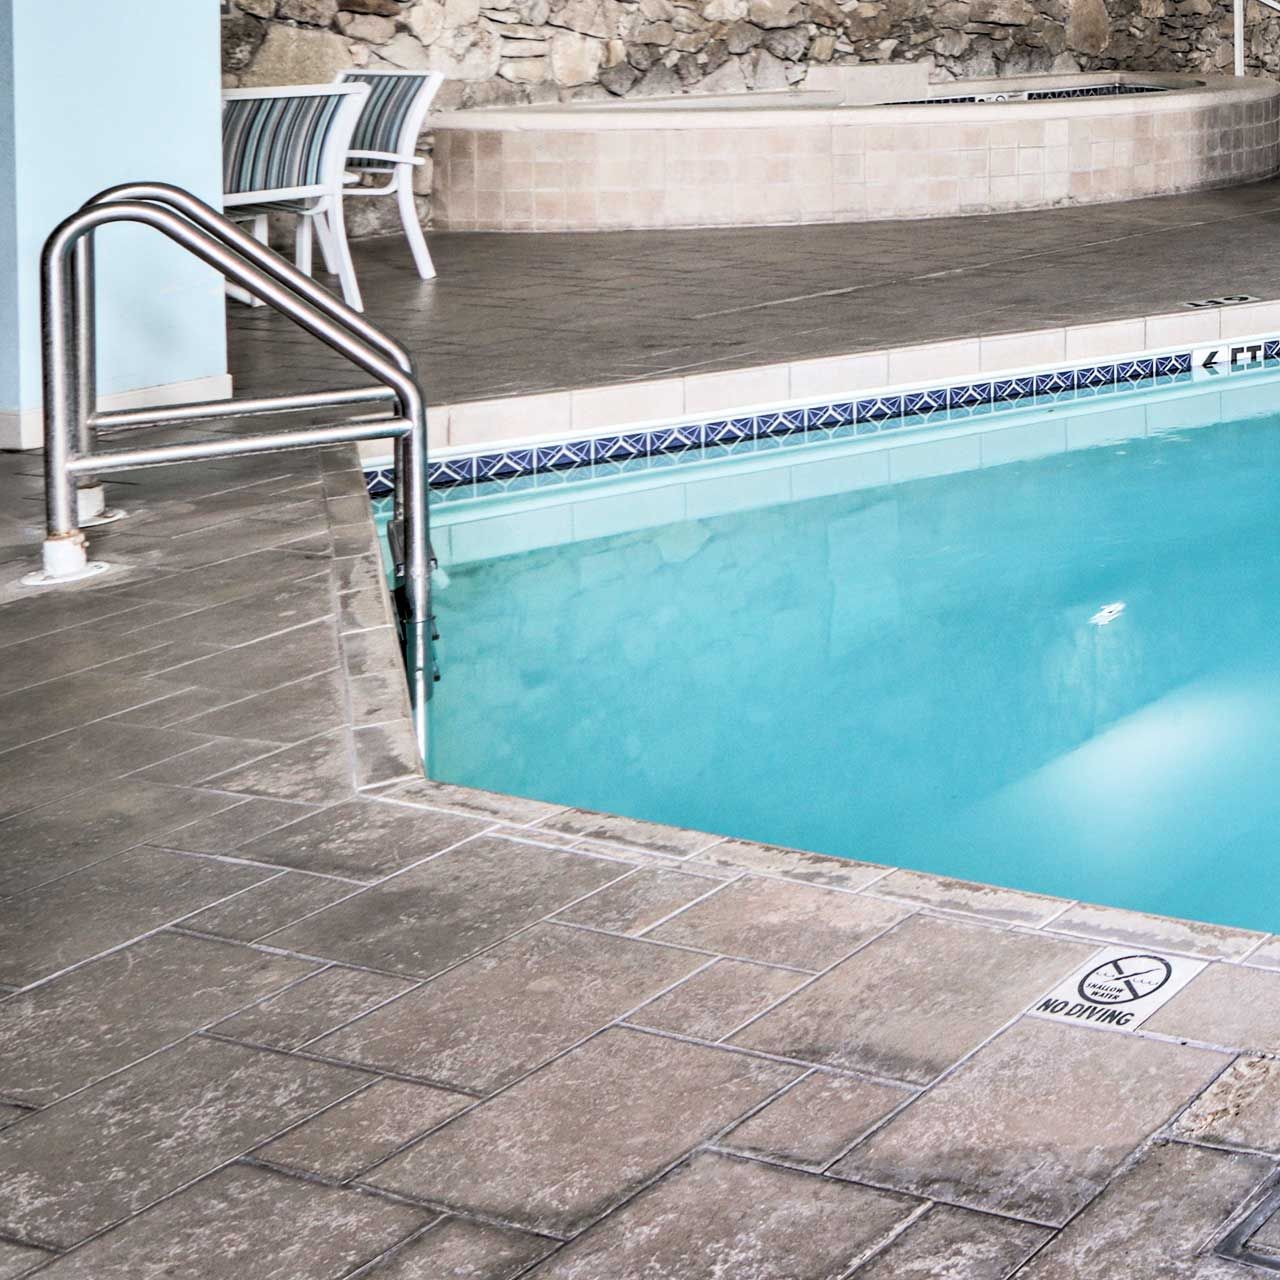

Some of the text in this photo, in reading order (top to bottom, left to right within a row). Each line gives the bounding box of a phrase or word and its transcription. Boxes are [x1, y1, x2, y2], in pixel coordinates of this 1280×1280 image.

[1086, 983, 1126, 994] SHALLOW
[1090, 990, 1120, 1001] WATER
[1036, 998, 1135, 1026] NO DIVING
